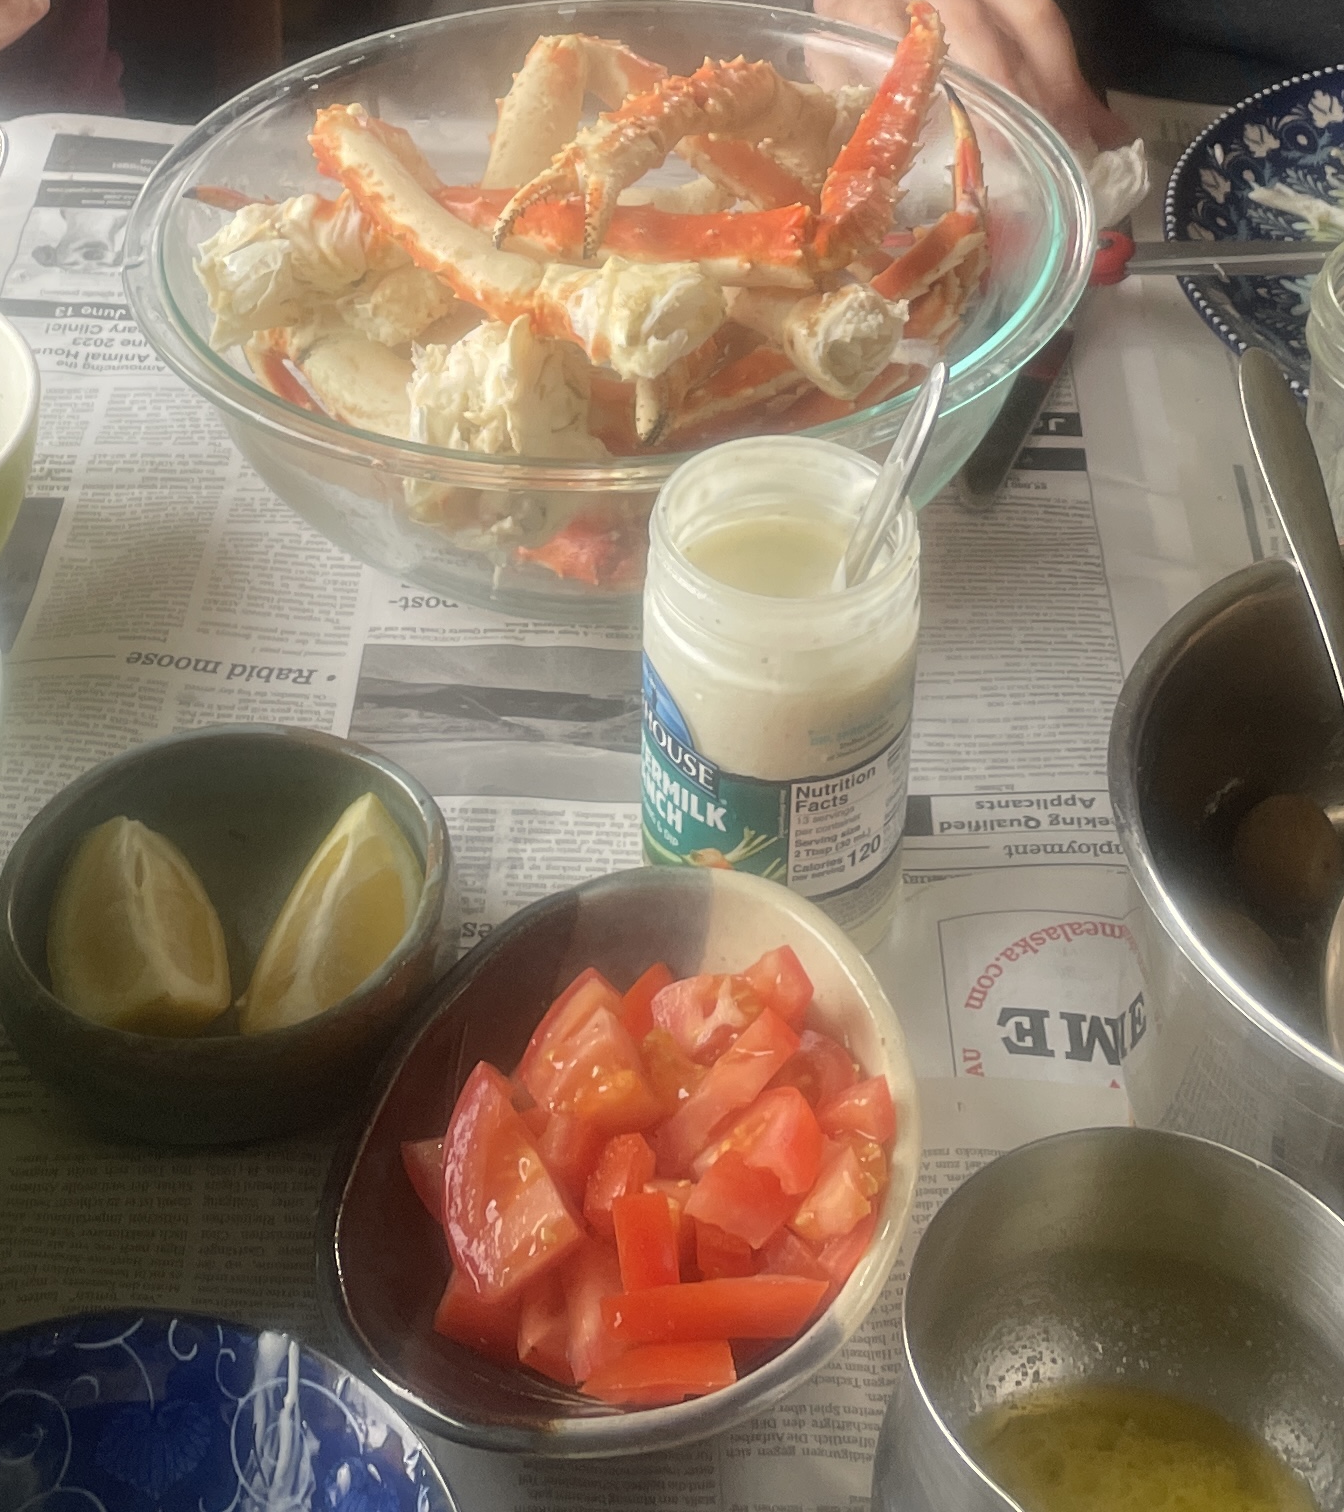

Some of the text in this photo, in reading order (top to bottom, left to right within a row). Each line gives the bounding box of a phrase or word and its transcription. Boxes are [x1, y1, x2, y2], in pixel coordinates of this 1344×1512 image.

[54, 305, 126, 318] June 13
[44, 321, 103, 335] Clinic!
[71, 336, 115, 347] 2023
[83, 351, 149, 364] Animal
[124, 650, 318, 685] Rabid moose
[796, 766, 876, 800] Nutrition
[796, 793, 848, 813] Facts
[975, 794, 1096, 811] Applicants
[938, 815, 1041, 833] Qualified
[795, 824, 861, 849] Serving size
[792, 834, 881, 874] Calories 120
[803, 842, 832, 859] Tbsp
